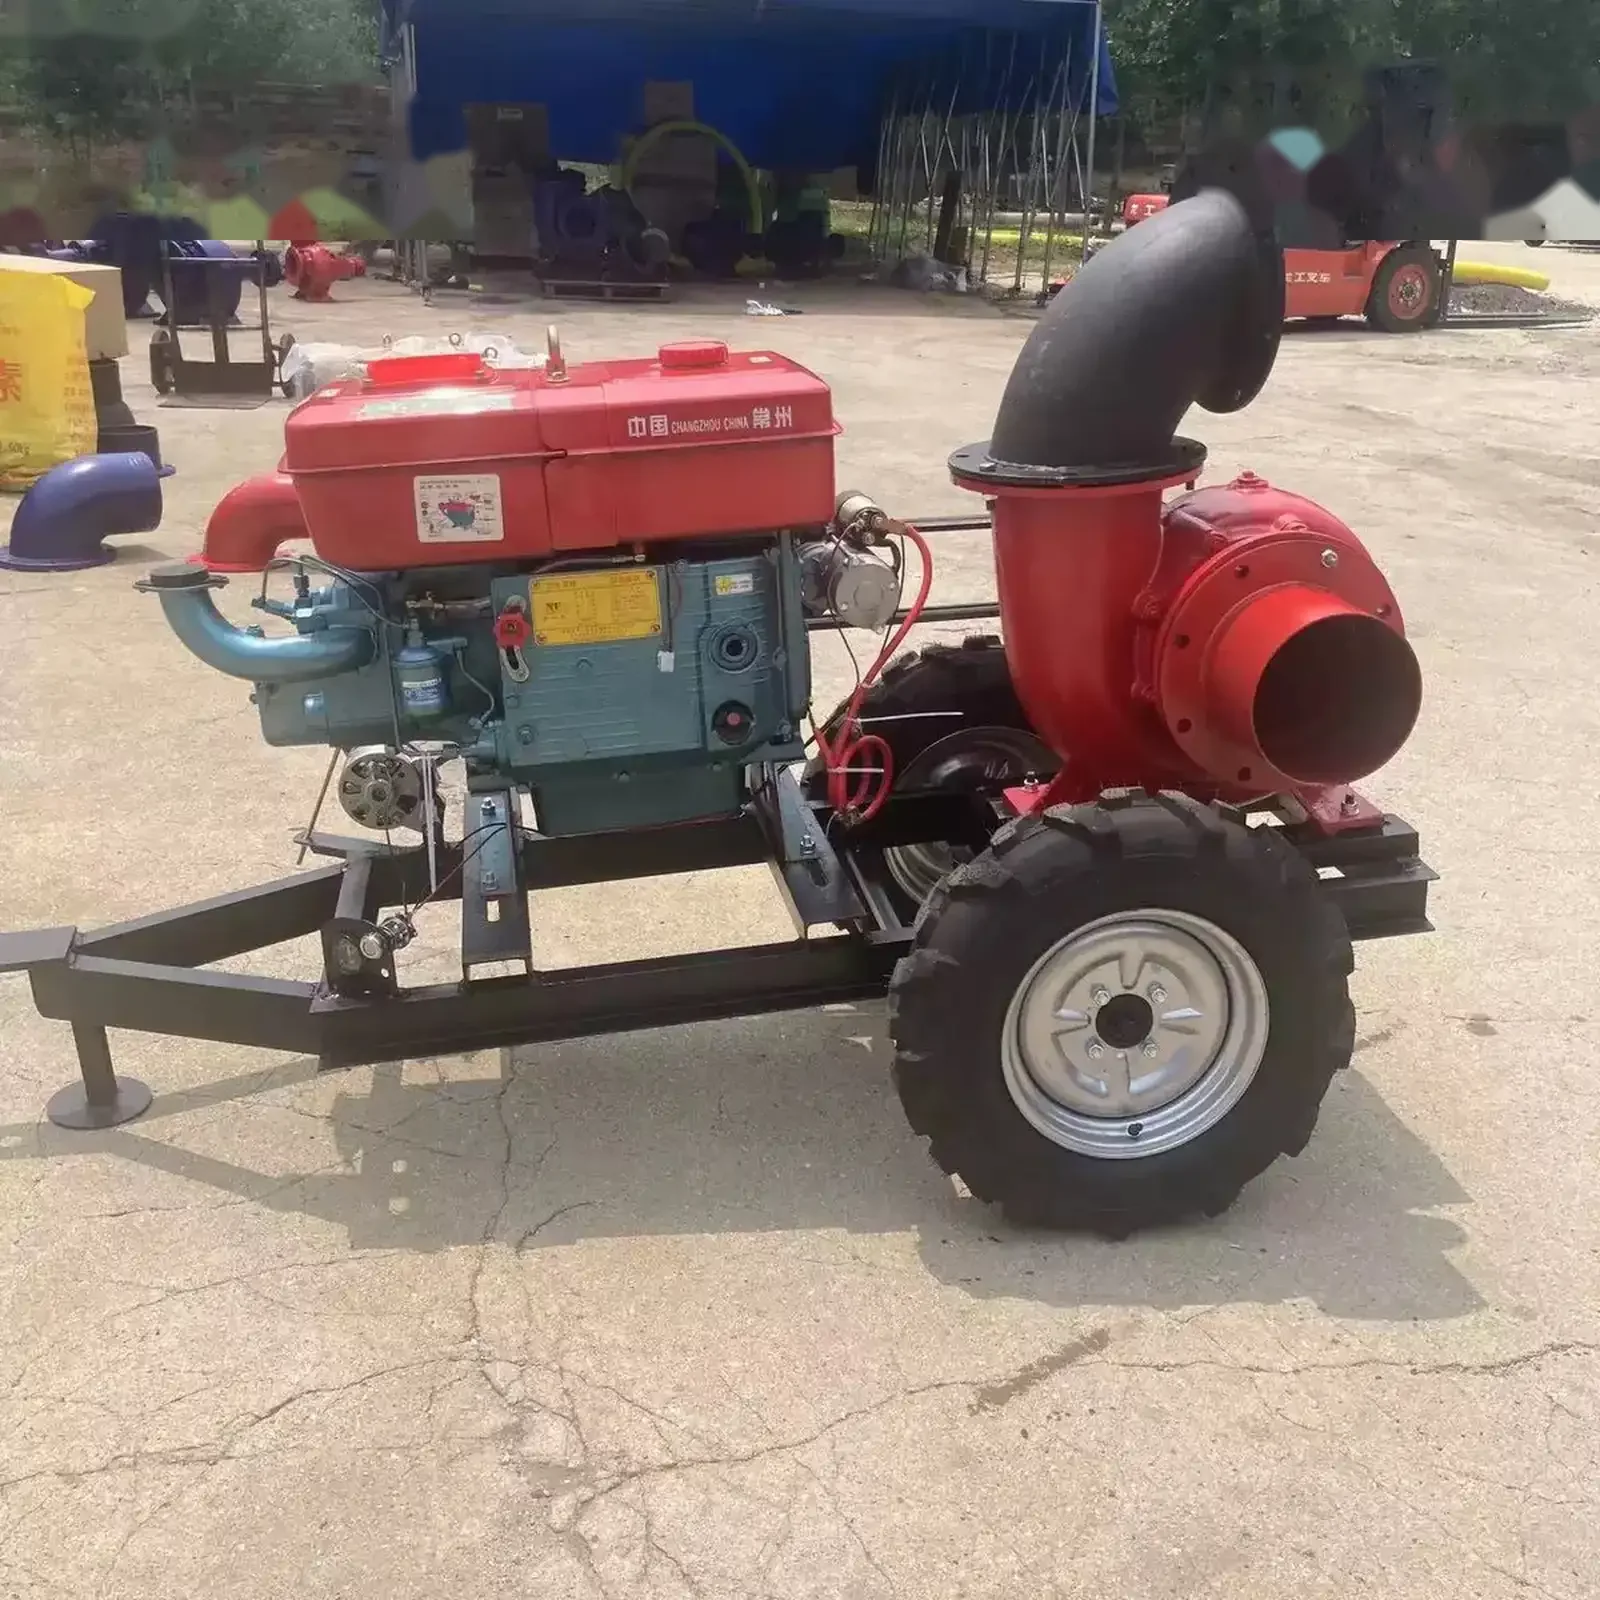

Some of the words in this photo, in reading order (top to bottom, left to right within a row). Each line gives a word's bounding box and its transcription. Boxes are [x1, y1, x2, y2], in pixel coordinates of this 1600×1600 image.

[628, 414, 669, 438] 中国
[671, 419, 721, 434] CHANGZHOU
[724, 416, 749, 431] CHINA
[752, 405, 792, 429] 常州
